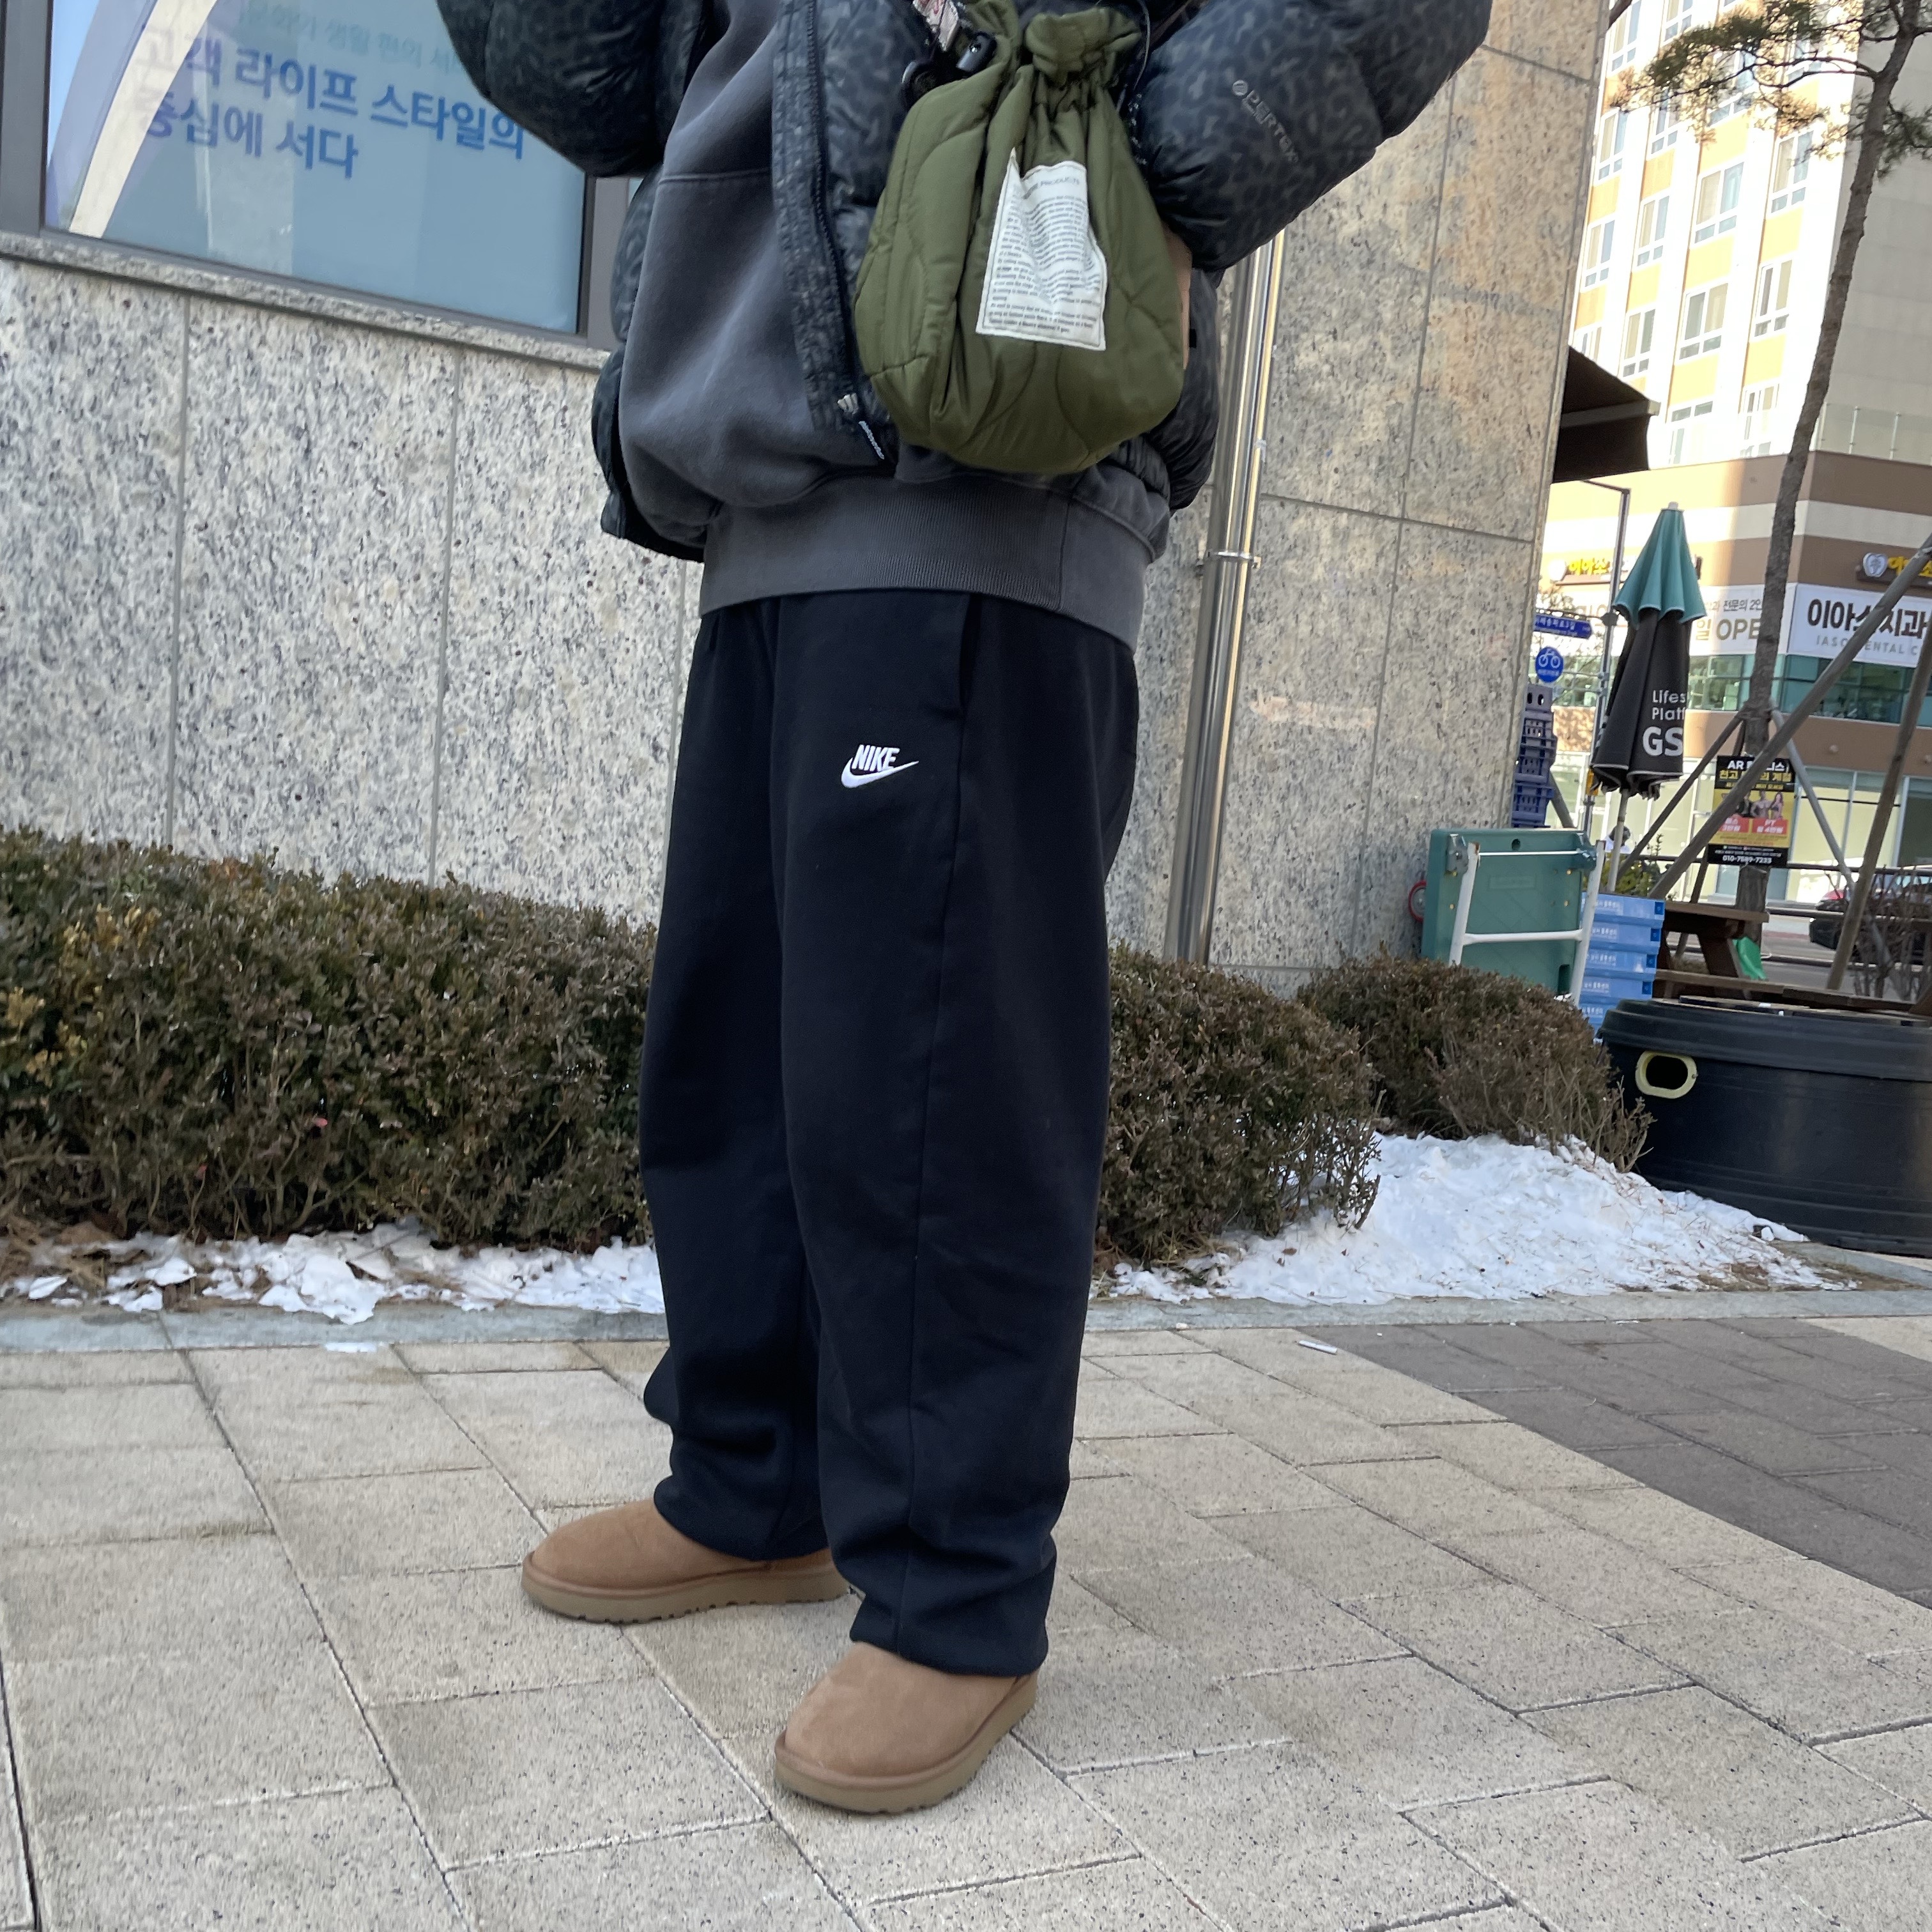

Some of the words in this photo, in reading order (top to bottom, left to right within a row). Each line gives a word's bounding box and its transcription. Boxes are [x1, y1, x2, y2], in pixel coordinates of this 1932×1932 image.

[235, 46, 358, 116] 라이프
[371, 84, 524, 160] 스타일의
[275, 119, 359, 180] 서다
[1864, 640, 1905, 655] ENTAL
[852, 744, 900, 772] NIKE
[1727, 760, 1745, 770] AR
